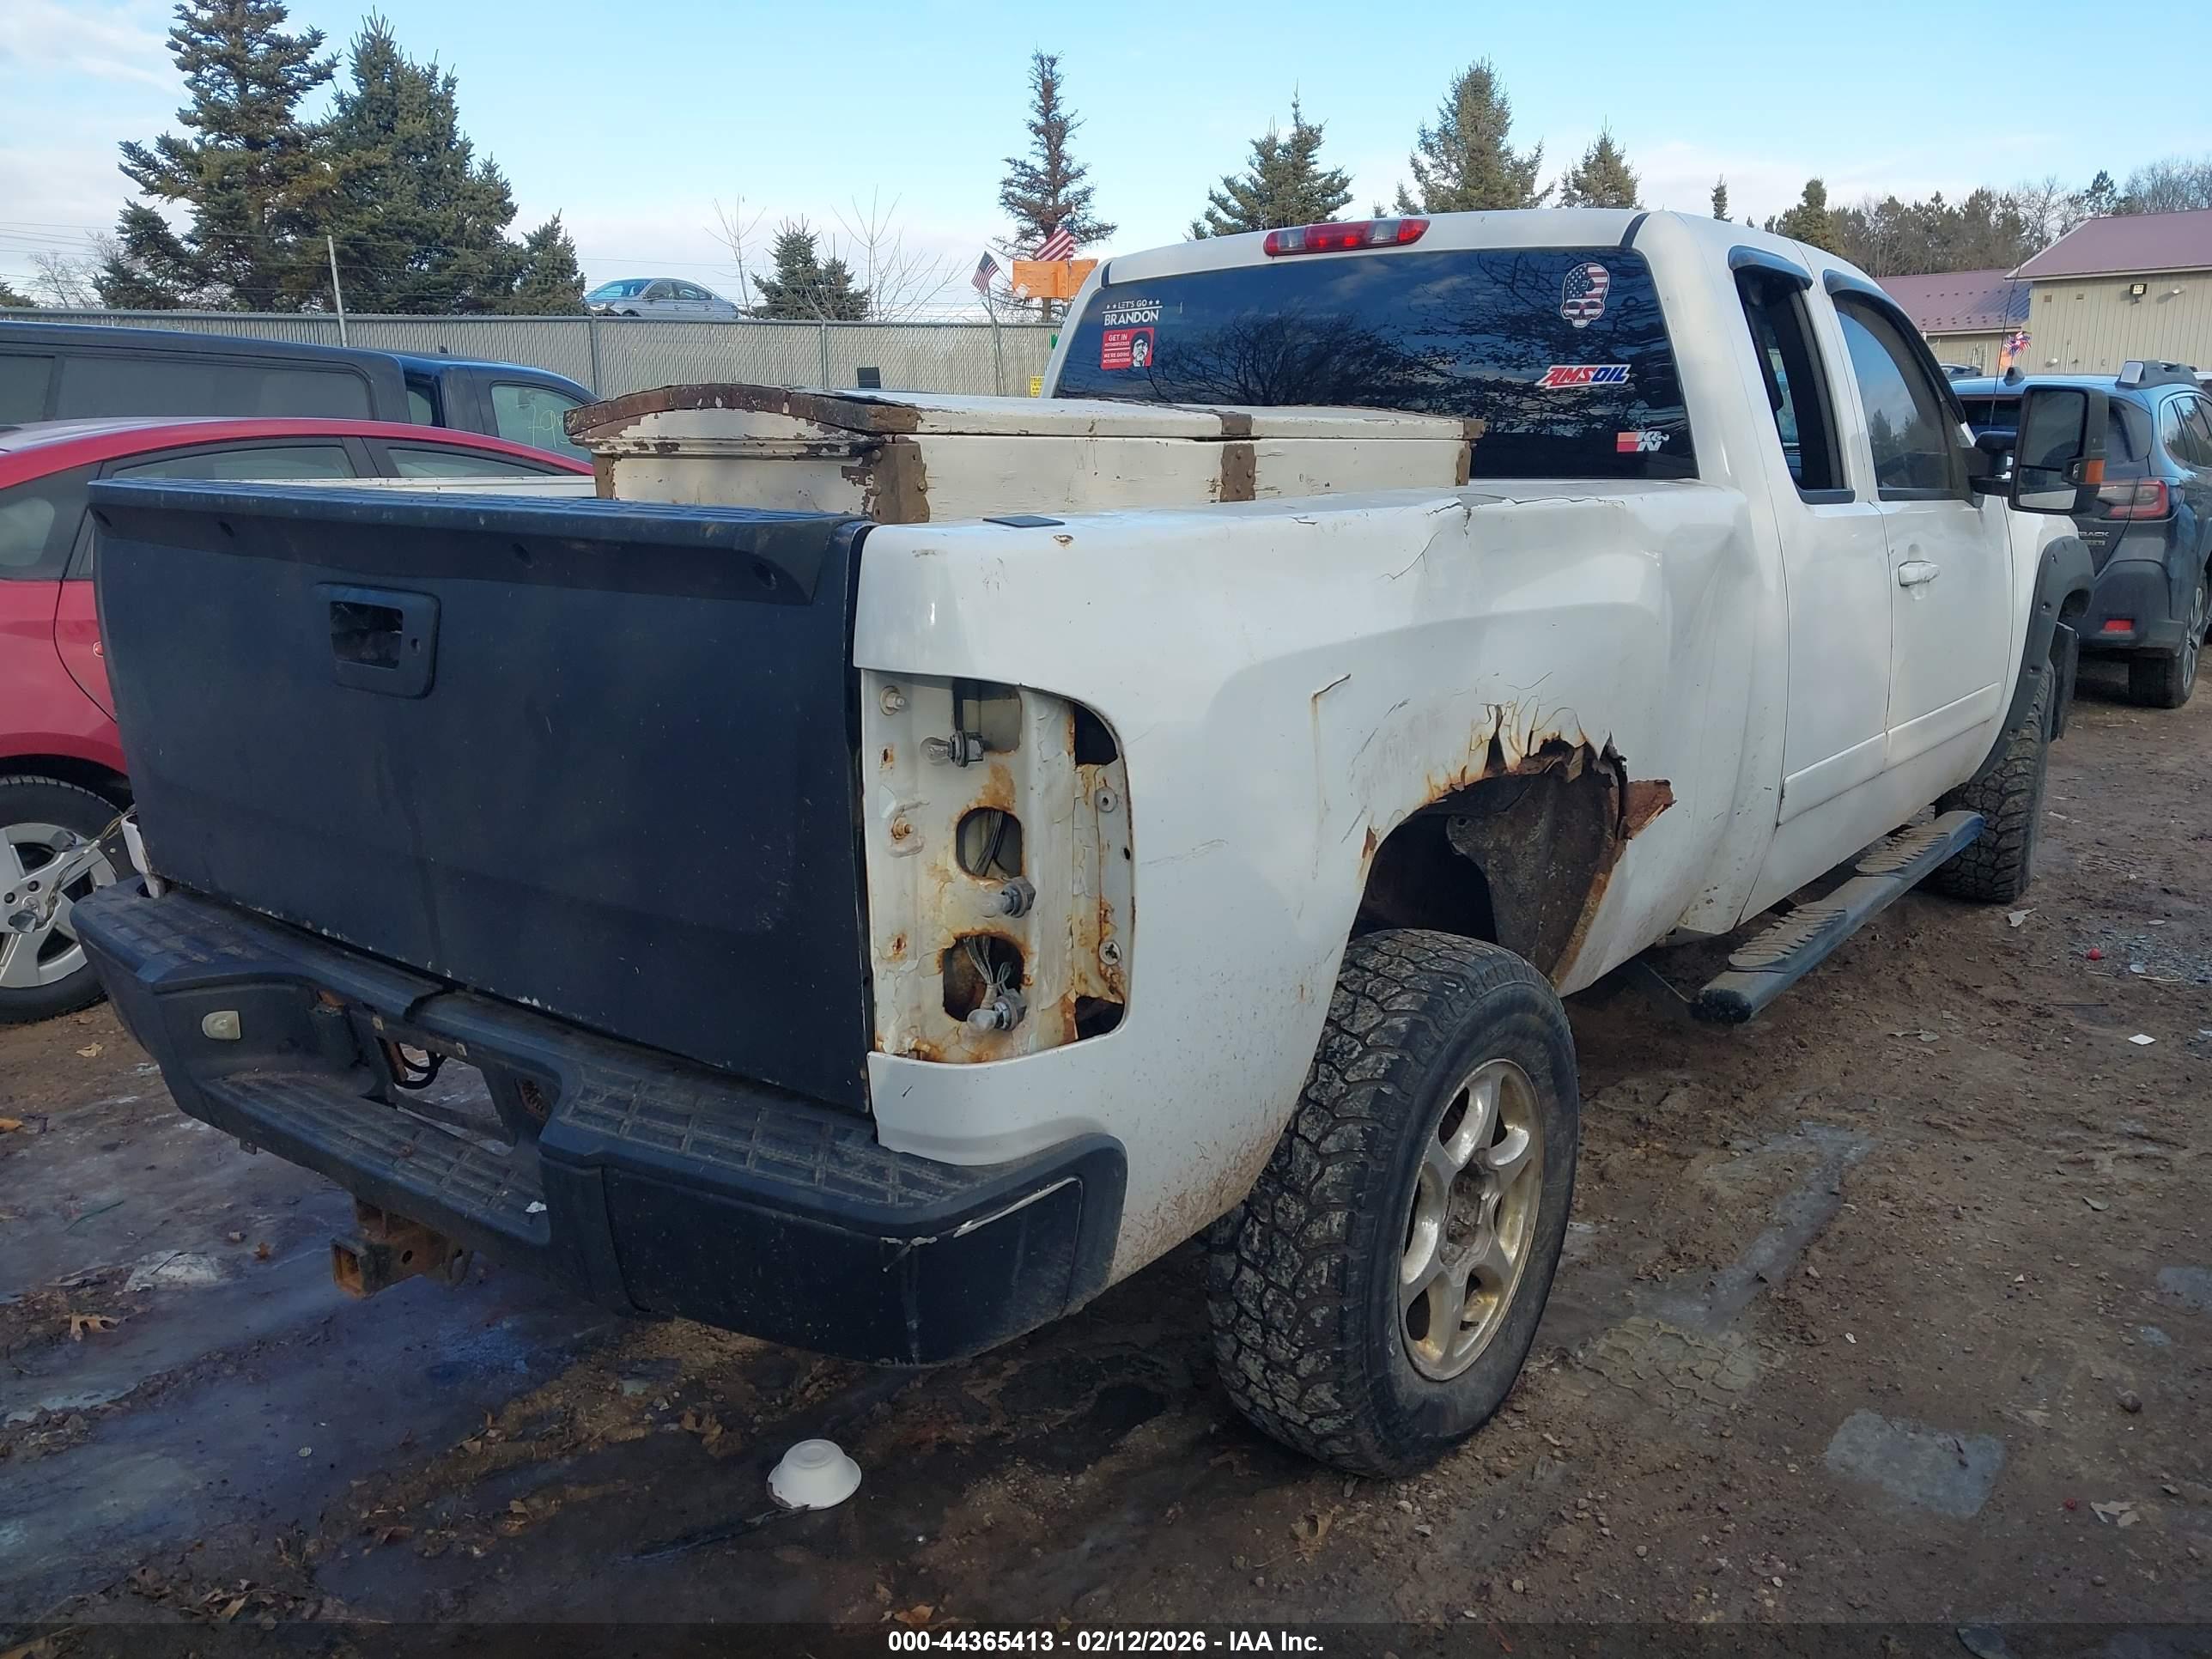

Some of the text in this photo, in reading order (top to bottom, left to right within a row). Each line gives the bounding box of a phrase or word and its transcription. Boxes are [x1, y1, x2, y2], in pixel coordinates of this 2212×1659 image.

[1118, 299, 1147, 309] LET'S GO
[1104, 309, 1159, 325] BRANDON
[1540, 367, 1628, 387] AMSOIL
